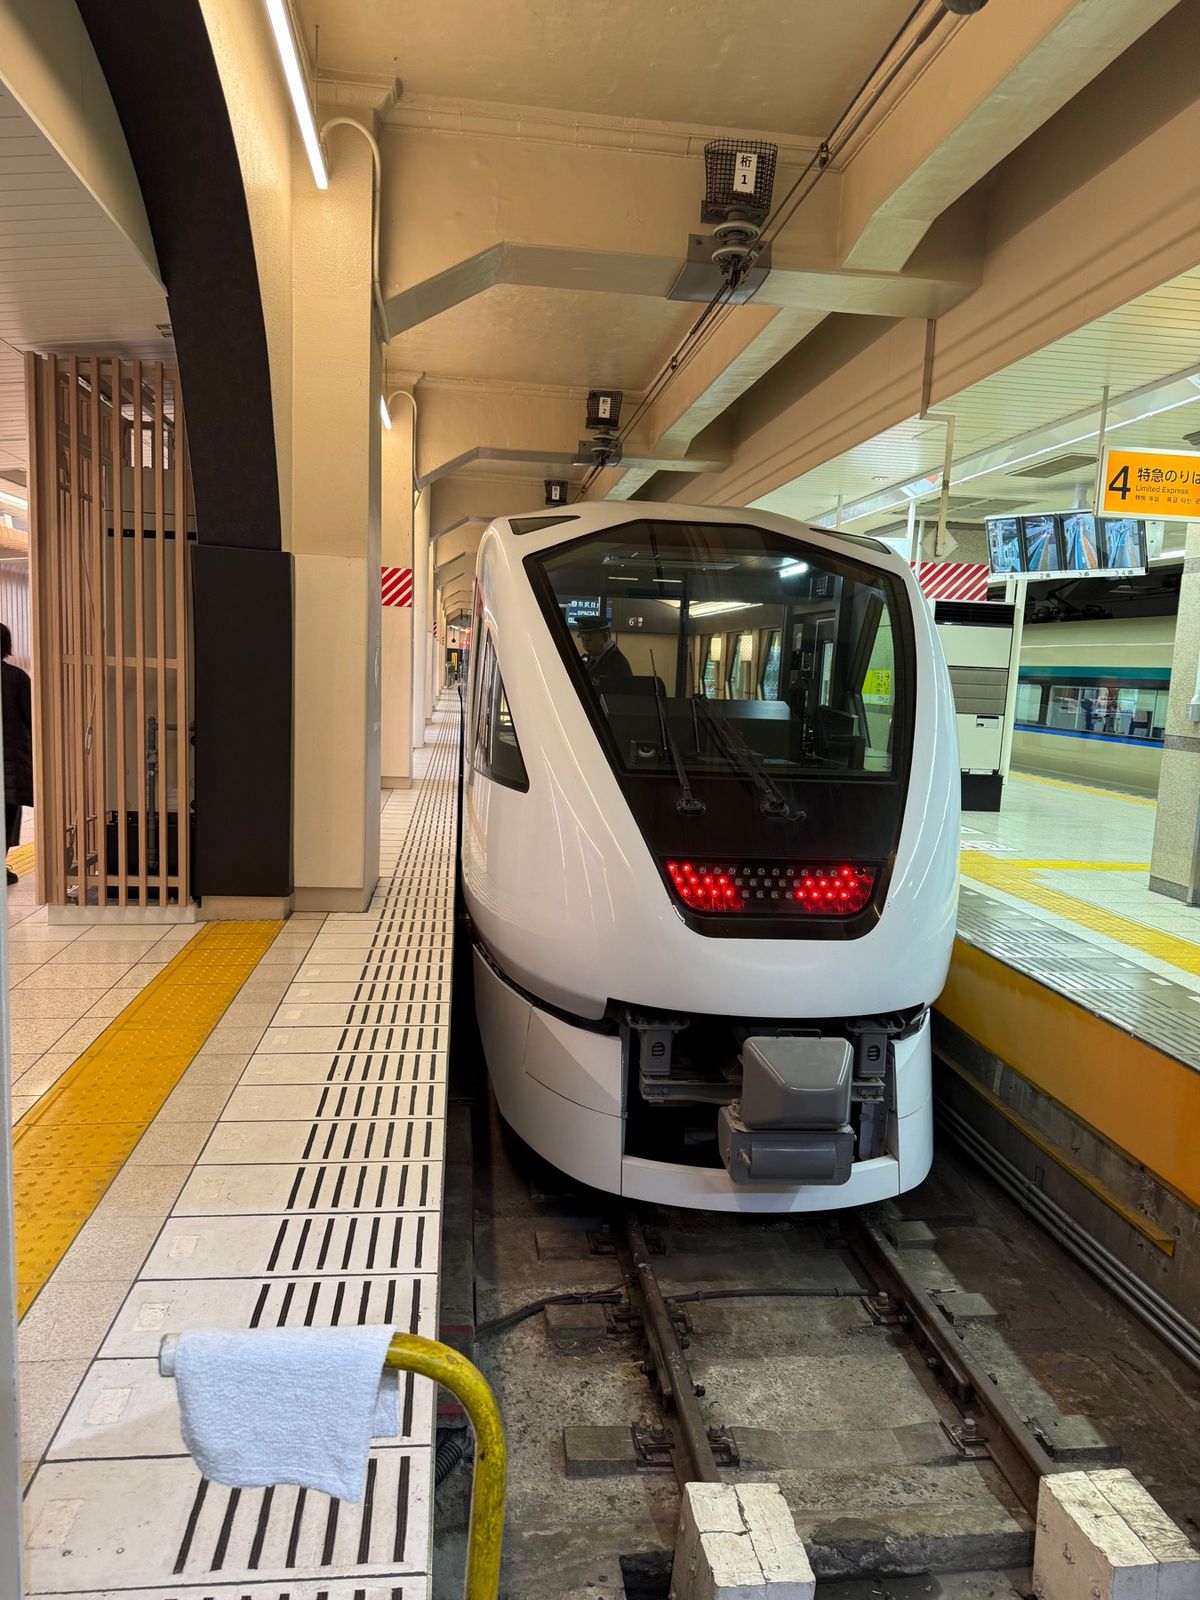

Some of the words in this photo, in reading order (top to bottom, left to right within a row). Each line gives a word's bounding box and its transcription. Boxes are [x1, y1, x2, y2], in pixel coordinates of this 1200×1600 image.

[740, 155, 752, 167] 桁
[741, 175, 748, 185] 1
[1108, 465, 1131, 500] 4
[1135, 485, 1161, 493] Limited
[1162, 486, 1189, 495] Express
[628, 617, 635, 626] 6
